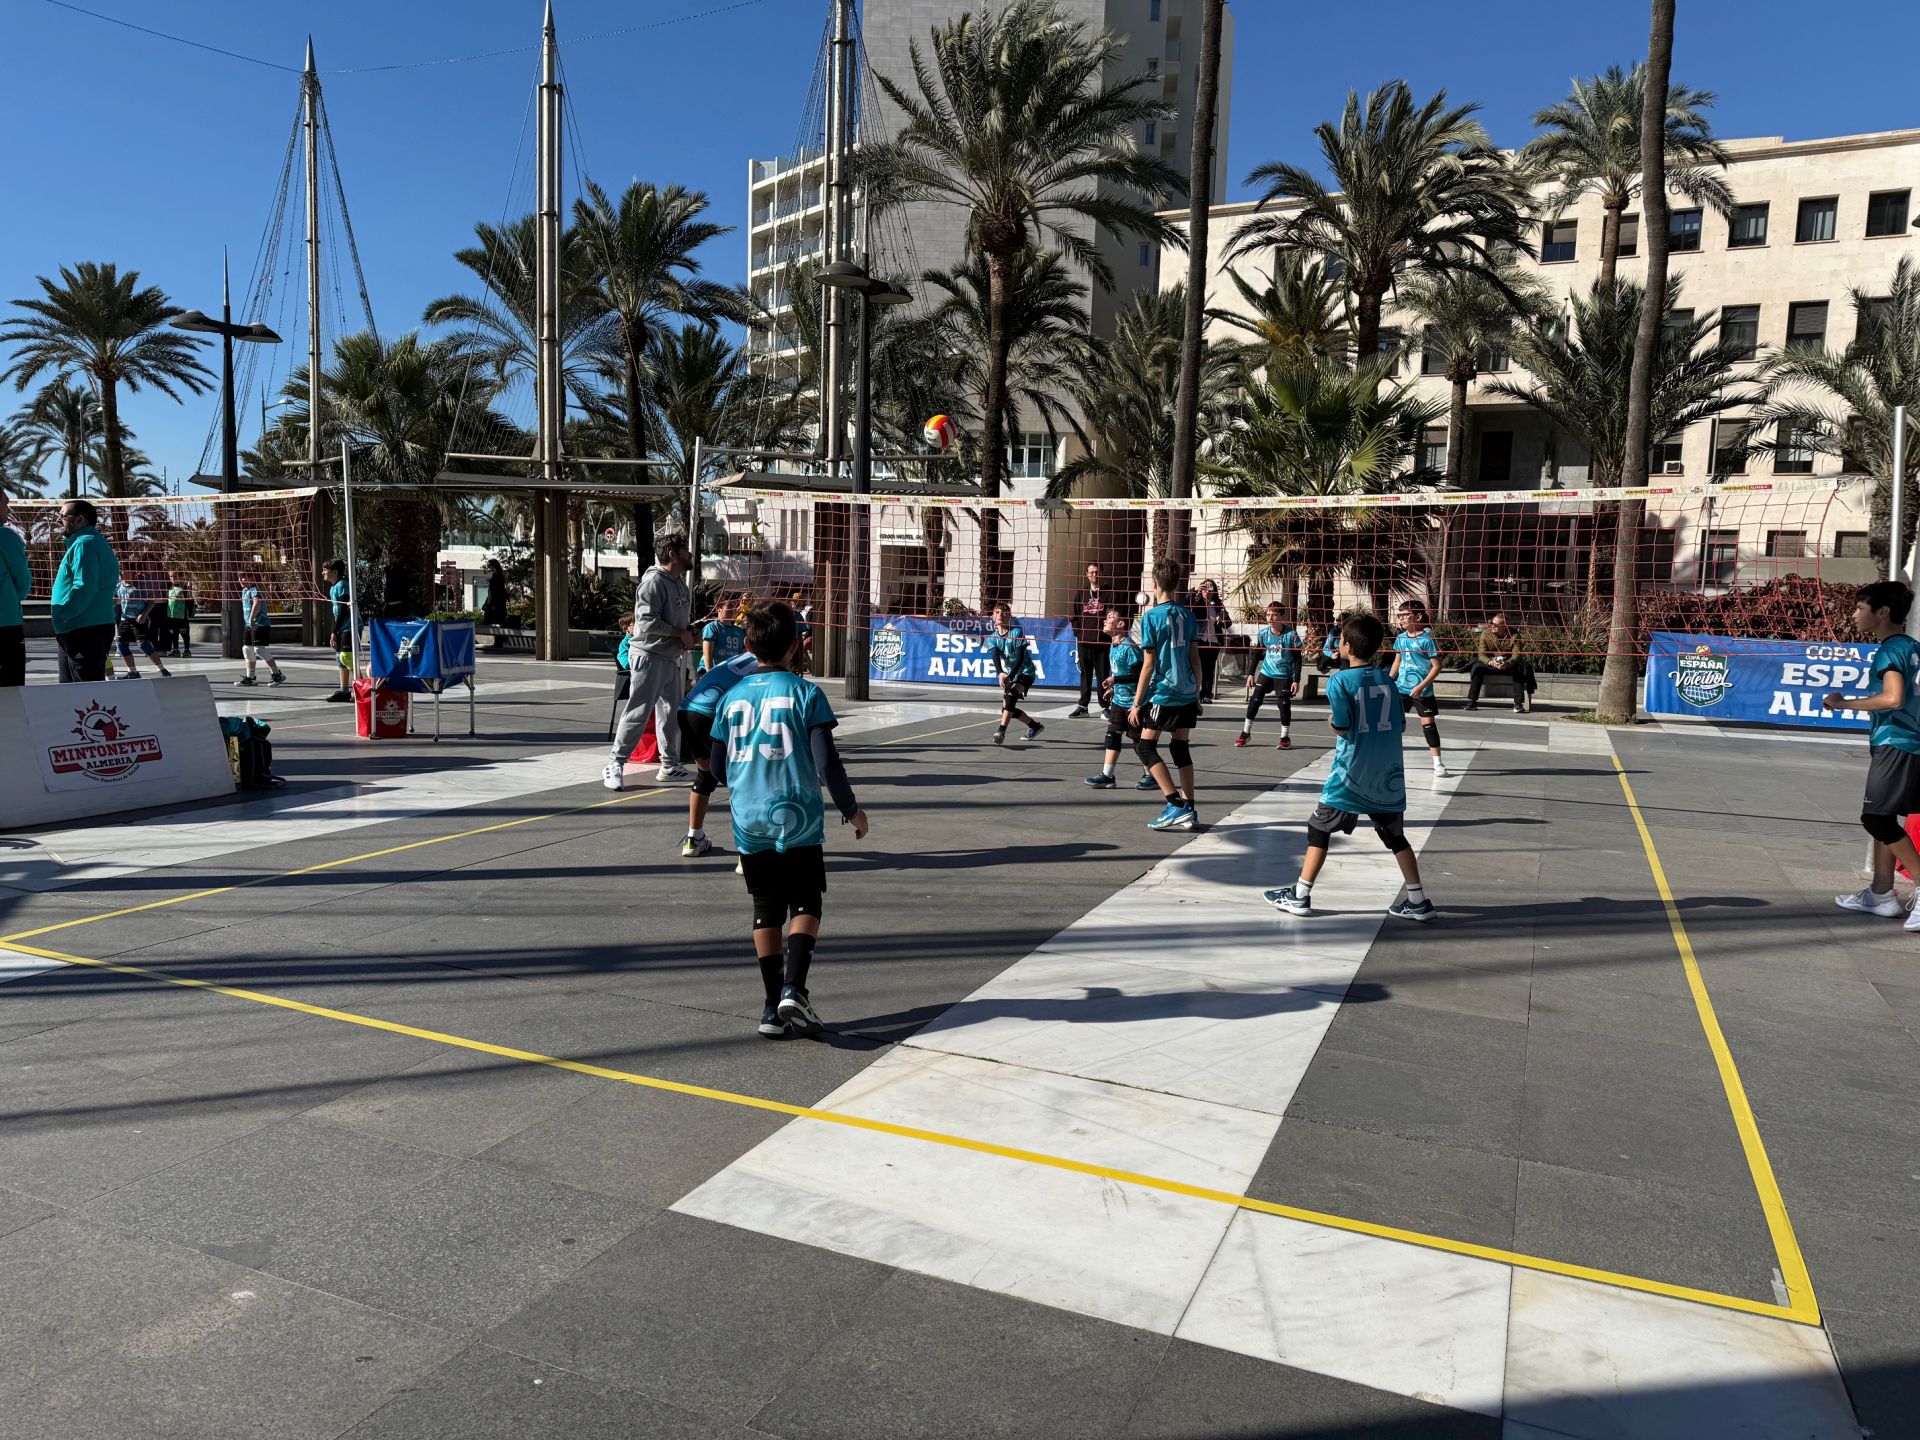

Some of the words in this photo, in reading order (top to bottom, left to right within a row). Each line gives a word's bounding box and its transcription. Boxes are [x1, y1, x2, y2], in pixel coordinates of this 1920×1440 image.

[949, 619, 981, 631] COPA
[1166, 612, 1186, 648] 11
[726, 635, 740, 649] 99
[935, 633, 1040, 654] ESPA
[1680, 659, 1724, 669] ESPAÑA
[1806, 645, 1860, 662] COPA
[1867, 648, 1879, 661] d
[928, 657, 1046, 679] ALMEA
[1668, 669, 1734, 690] Voleibol
[1354, 684, 1392, 734] 17
[726, 696, 795, 763] 25
[52, 738, 158, 764] MINTONETTE
[86, 756, 133, 770] ALMERIA
